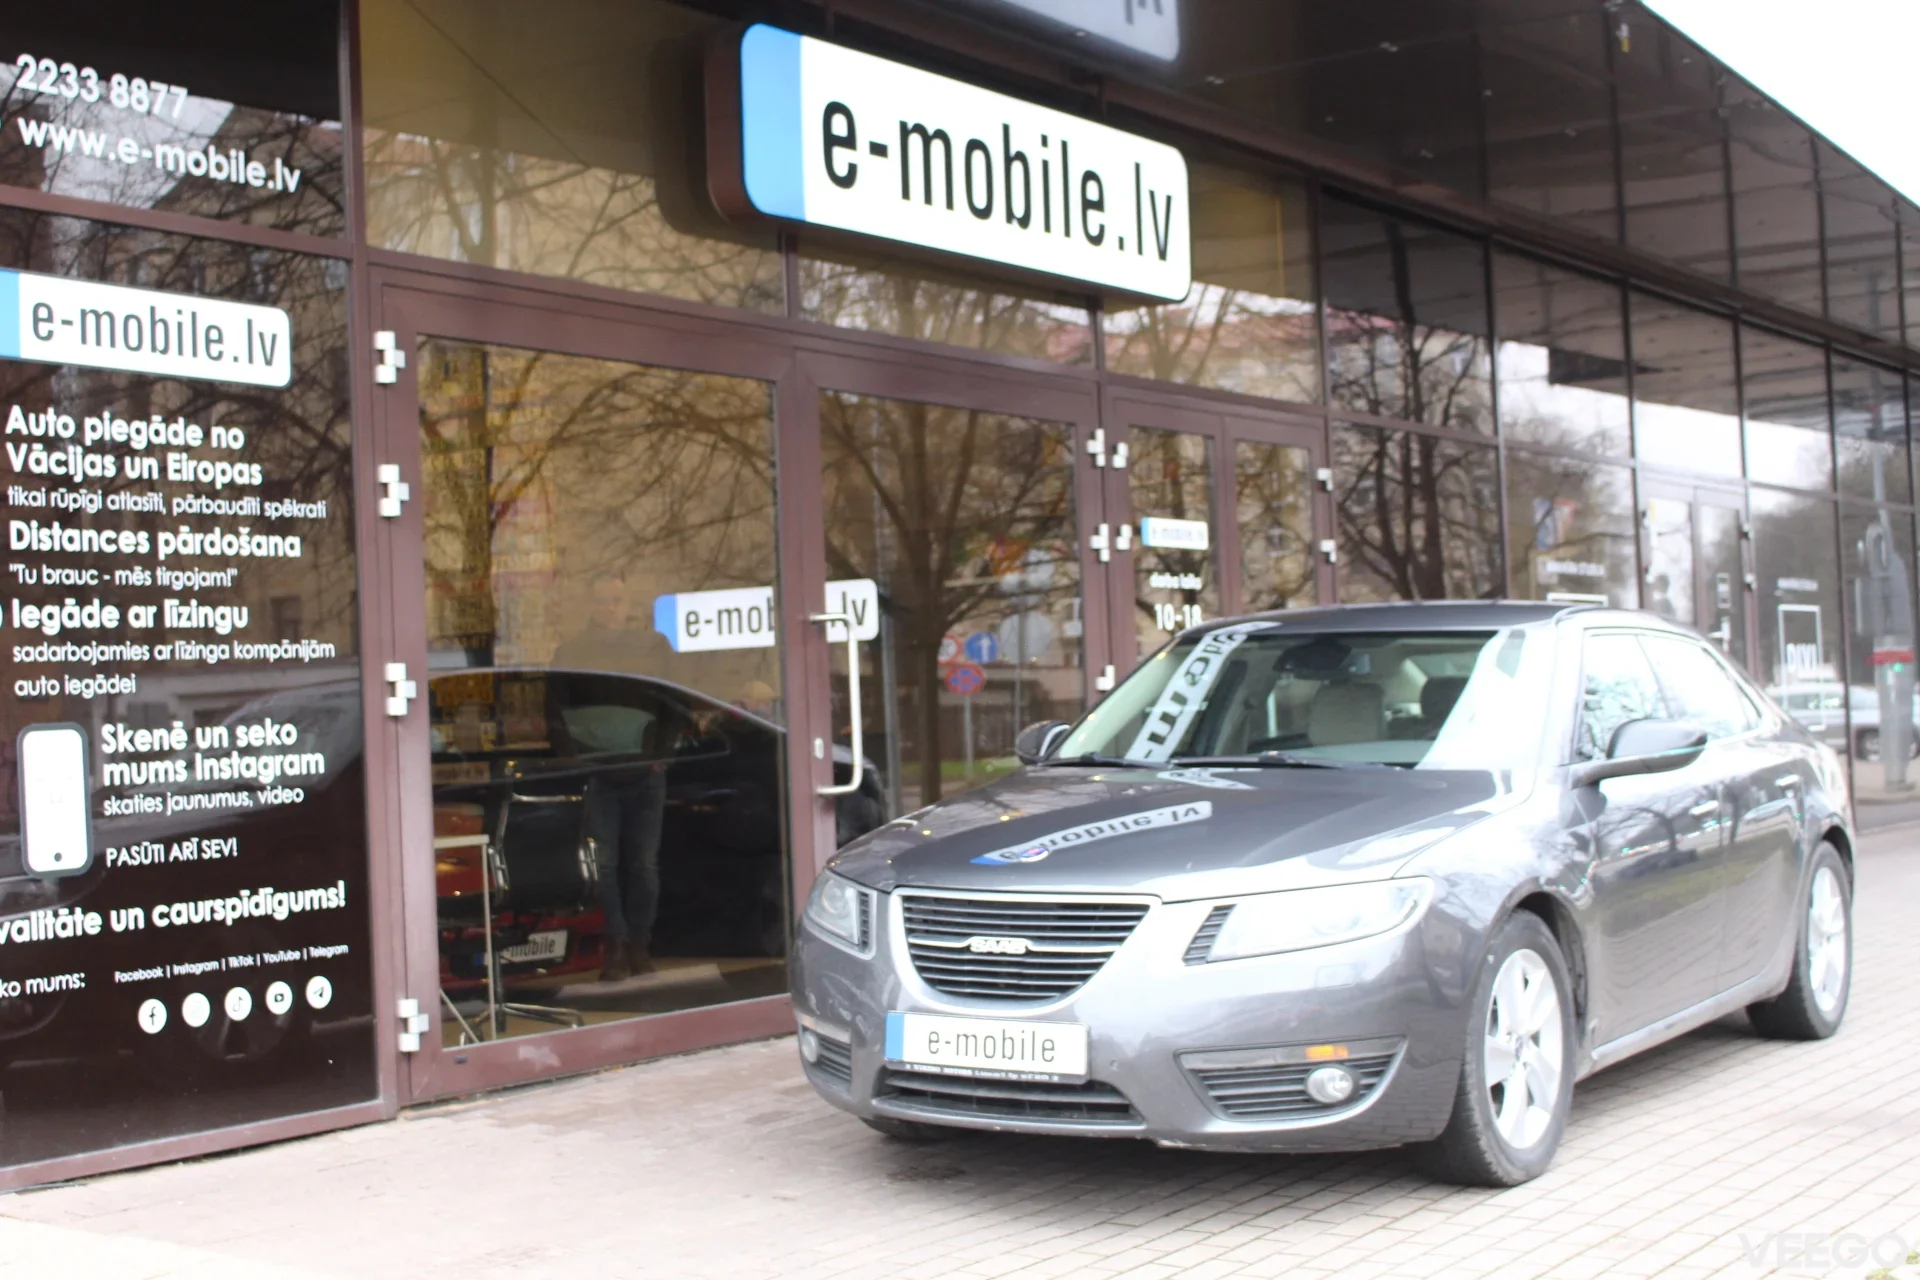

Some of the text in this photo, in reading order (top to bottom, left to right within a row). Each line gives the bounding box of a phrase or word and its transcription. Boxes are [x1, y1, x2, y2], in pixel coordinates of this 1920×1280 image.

[16, 53, 188, 119] 2233 8877
[17, 117, 301, 193] www.e-mobile.lv
[822, 101, 1172, 262] e-mobile.lv
[32, 300, 277, 367] e-mobile.lv
[5, 404, 245, 450] Auto piegāde no
[5, 441, 263, 490] Vācijas un Eiropas
[7, 485, 46, 507] tikai
[51, 488, 103, 514] rūpīgi
[172, 494, 261, 517] pārbaudīti
[264, 498, 327, 520] spēkrati
[9, 519, 302, 561] Distances pārdošana
[9, 563, 37, 586] "Tu
[42, 564, 98, 586] brauc
[115, 566, 152, 587] mēs
[156, 566, 238, 591] tirgojam!"
[11, 598, 249, 636] Iegāde ar līzingu
[12, 639, 335, 666] sadarbojamies ar līzinga kompānijām
[14, 673, 136, 699] auto iegādei
[101, 718, 297, 754] Skenē un seko
[102, 750, 325, 786] mums Instagram
[103, 785, 304, 816] skaties jaunumus, video
[105, 836, 239, 868] PASŪTI ARĪ SEV!
[109, 907, 145, 933] un
[152, 880, 346, 926] caurspīdīgums!
[114, 965, 164, 983] Facebook
[173, 959, 219, 976] Instagram
[263, 949, 301, 965] YouTube
[309, 943, 349, 959] Telegram
[969, 937, 1026, 955] SAAB
[26, 972, 86, 995] mums:
[927, 1028, 1056, 1063] e-mobile
